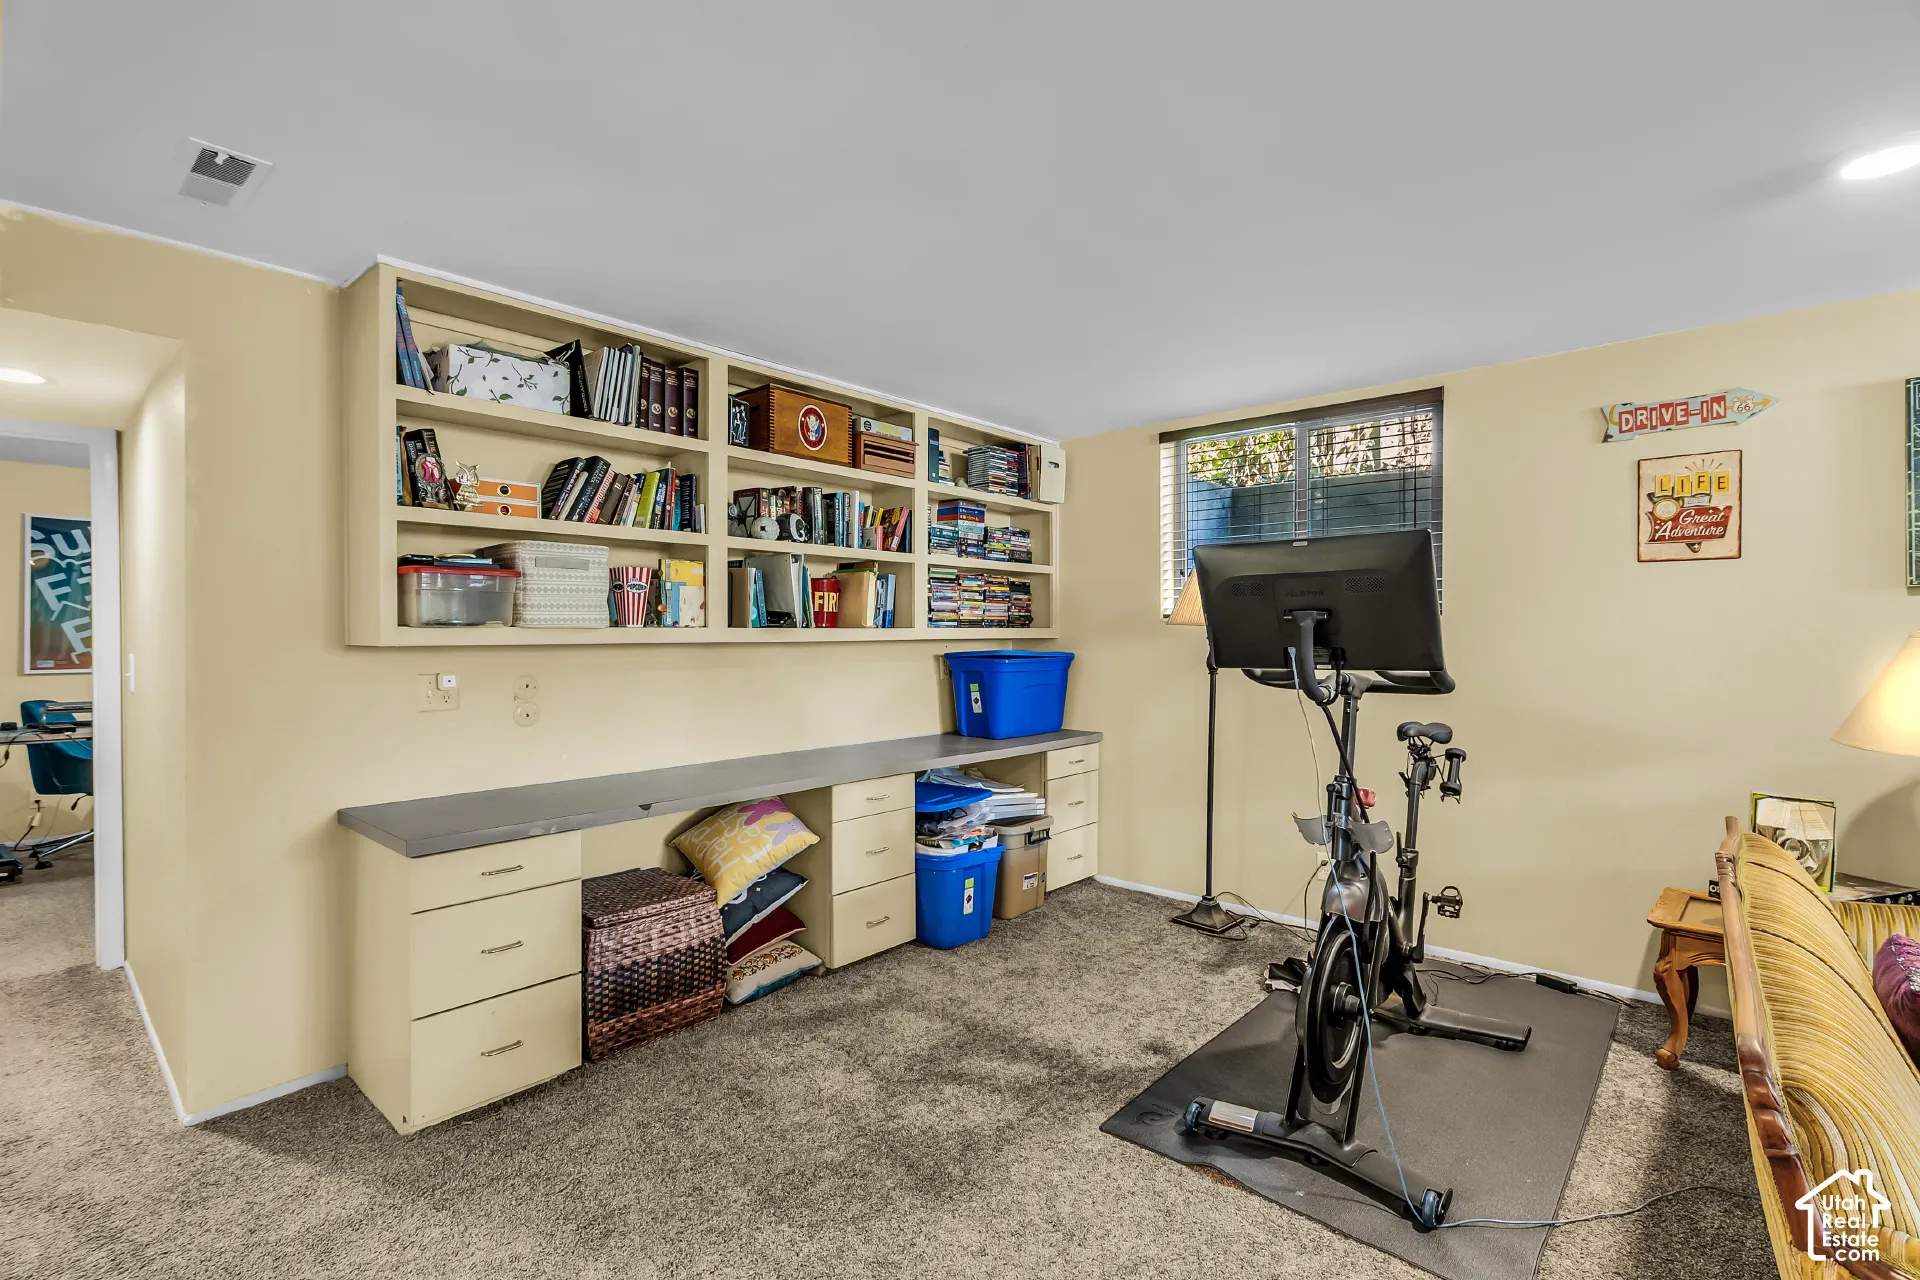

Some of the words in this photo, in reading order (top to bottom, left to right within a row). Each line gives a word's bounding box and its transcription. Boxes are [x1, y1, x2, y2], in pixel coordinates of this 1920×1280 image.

[1620, 400, 1726, 431] DRIVE-IN
[1736, 402, 1751, 412] 66
[1660, 474, 1727, 492] LIFE
[1679, 509, 1725, 525] Great
[1654, 520, 1725, 540] Adventure
